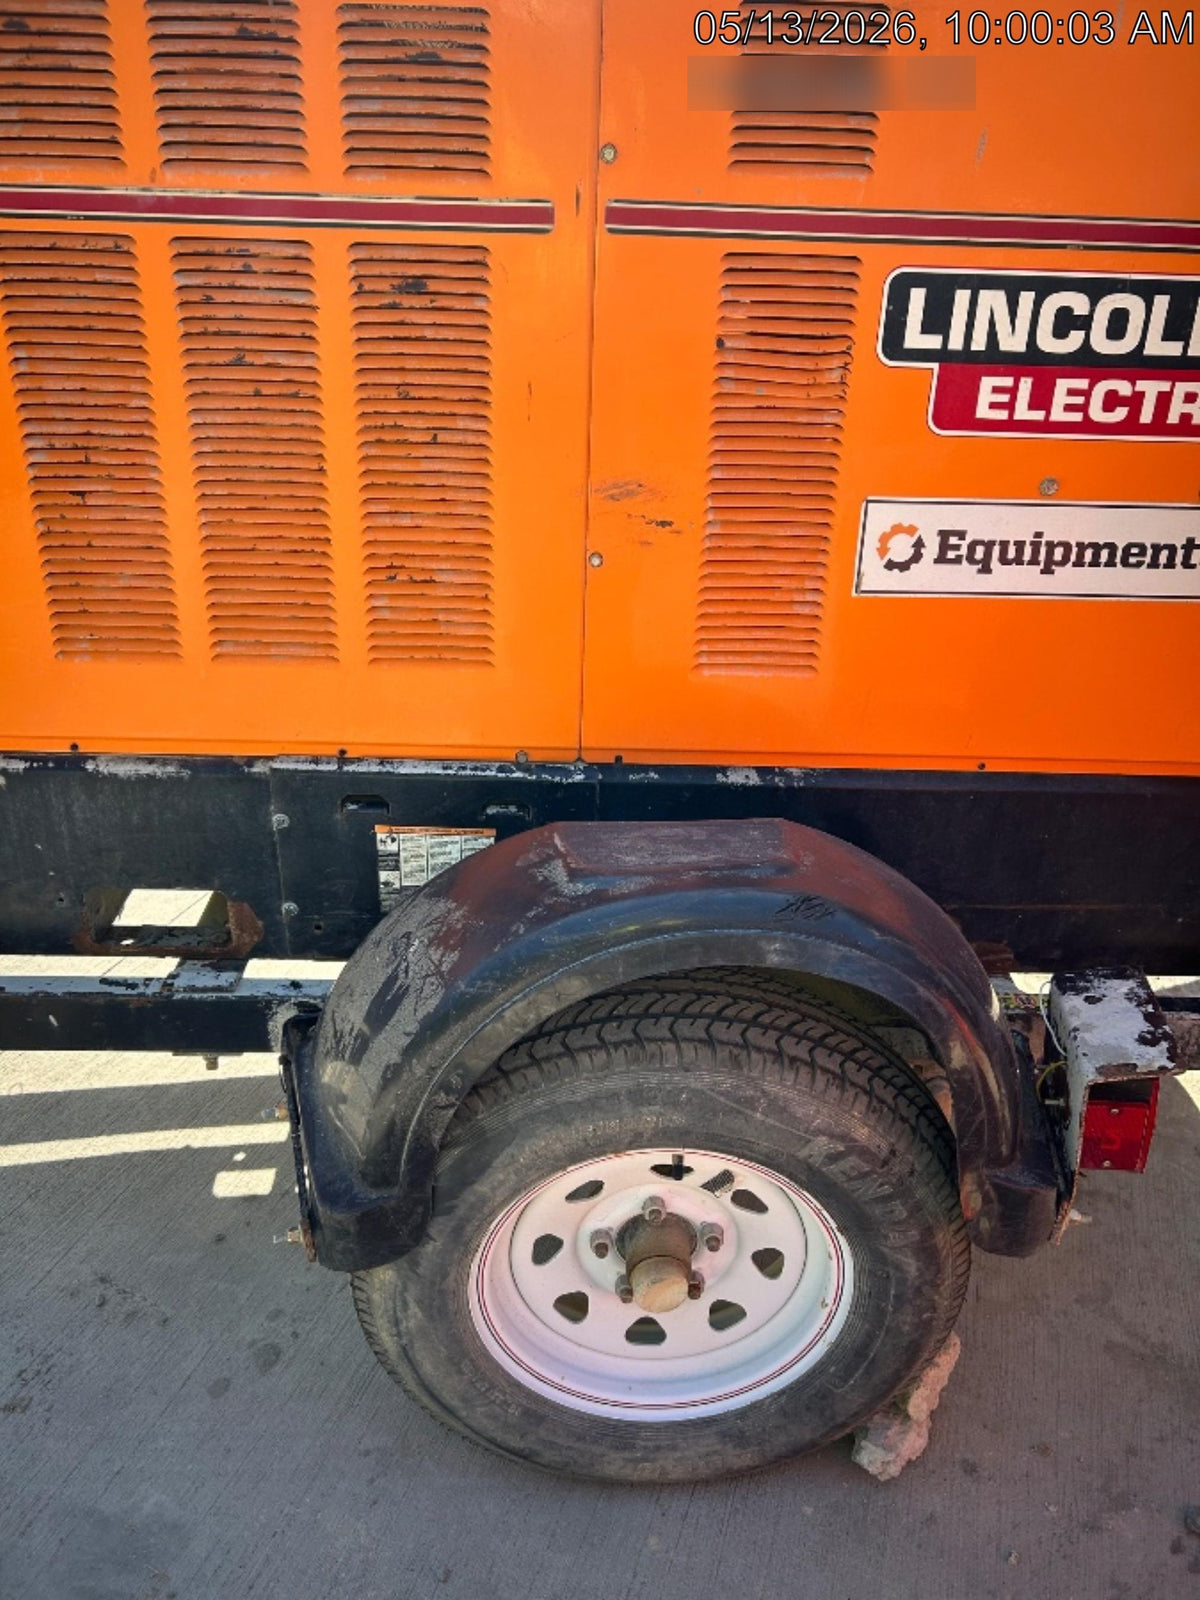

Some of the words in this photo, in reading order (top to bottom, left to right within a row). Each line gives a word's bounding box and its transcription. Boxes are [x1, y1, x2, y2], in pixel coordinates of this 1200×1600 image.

[903, 287, 1200, 357] LINCOL
[975, 376, 1200, 425] ELECTR
[933, 529, 1200, 575] Equipment
